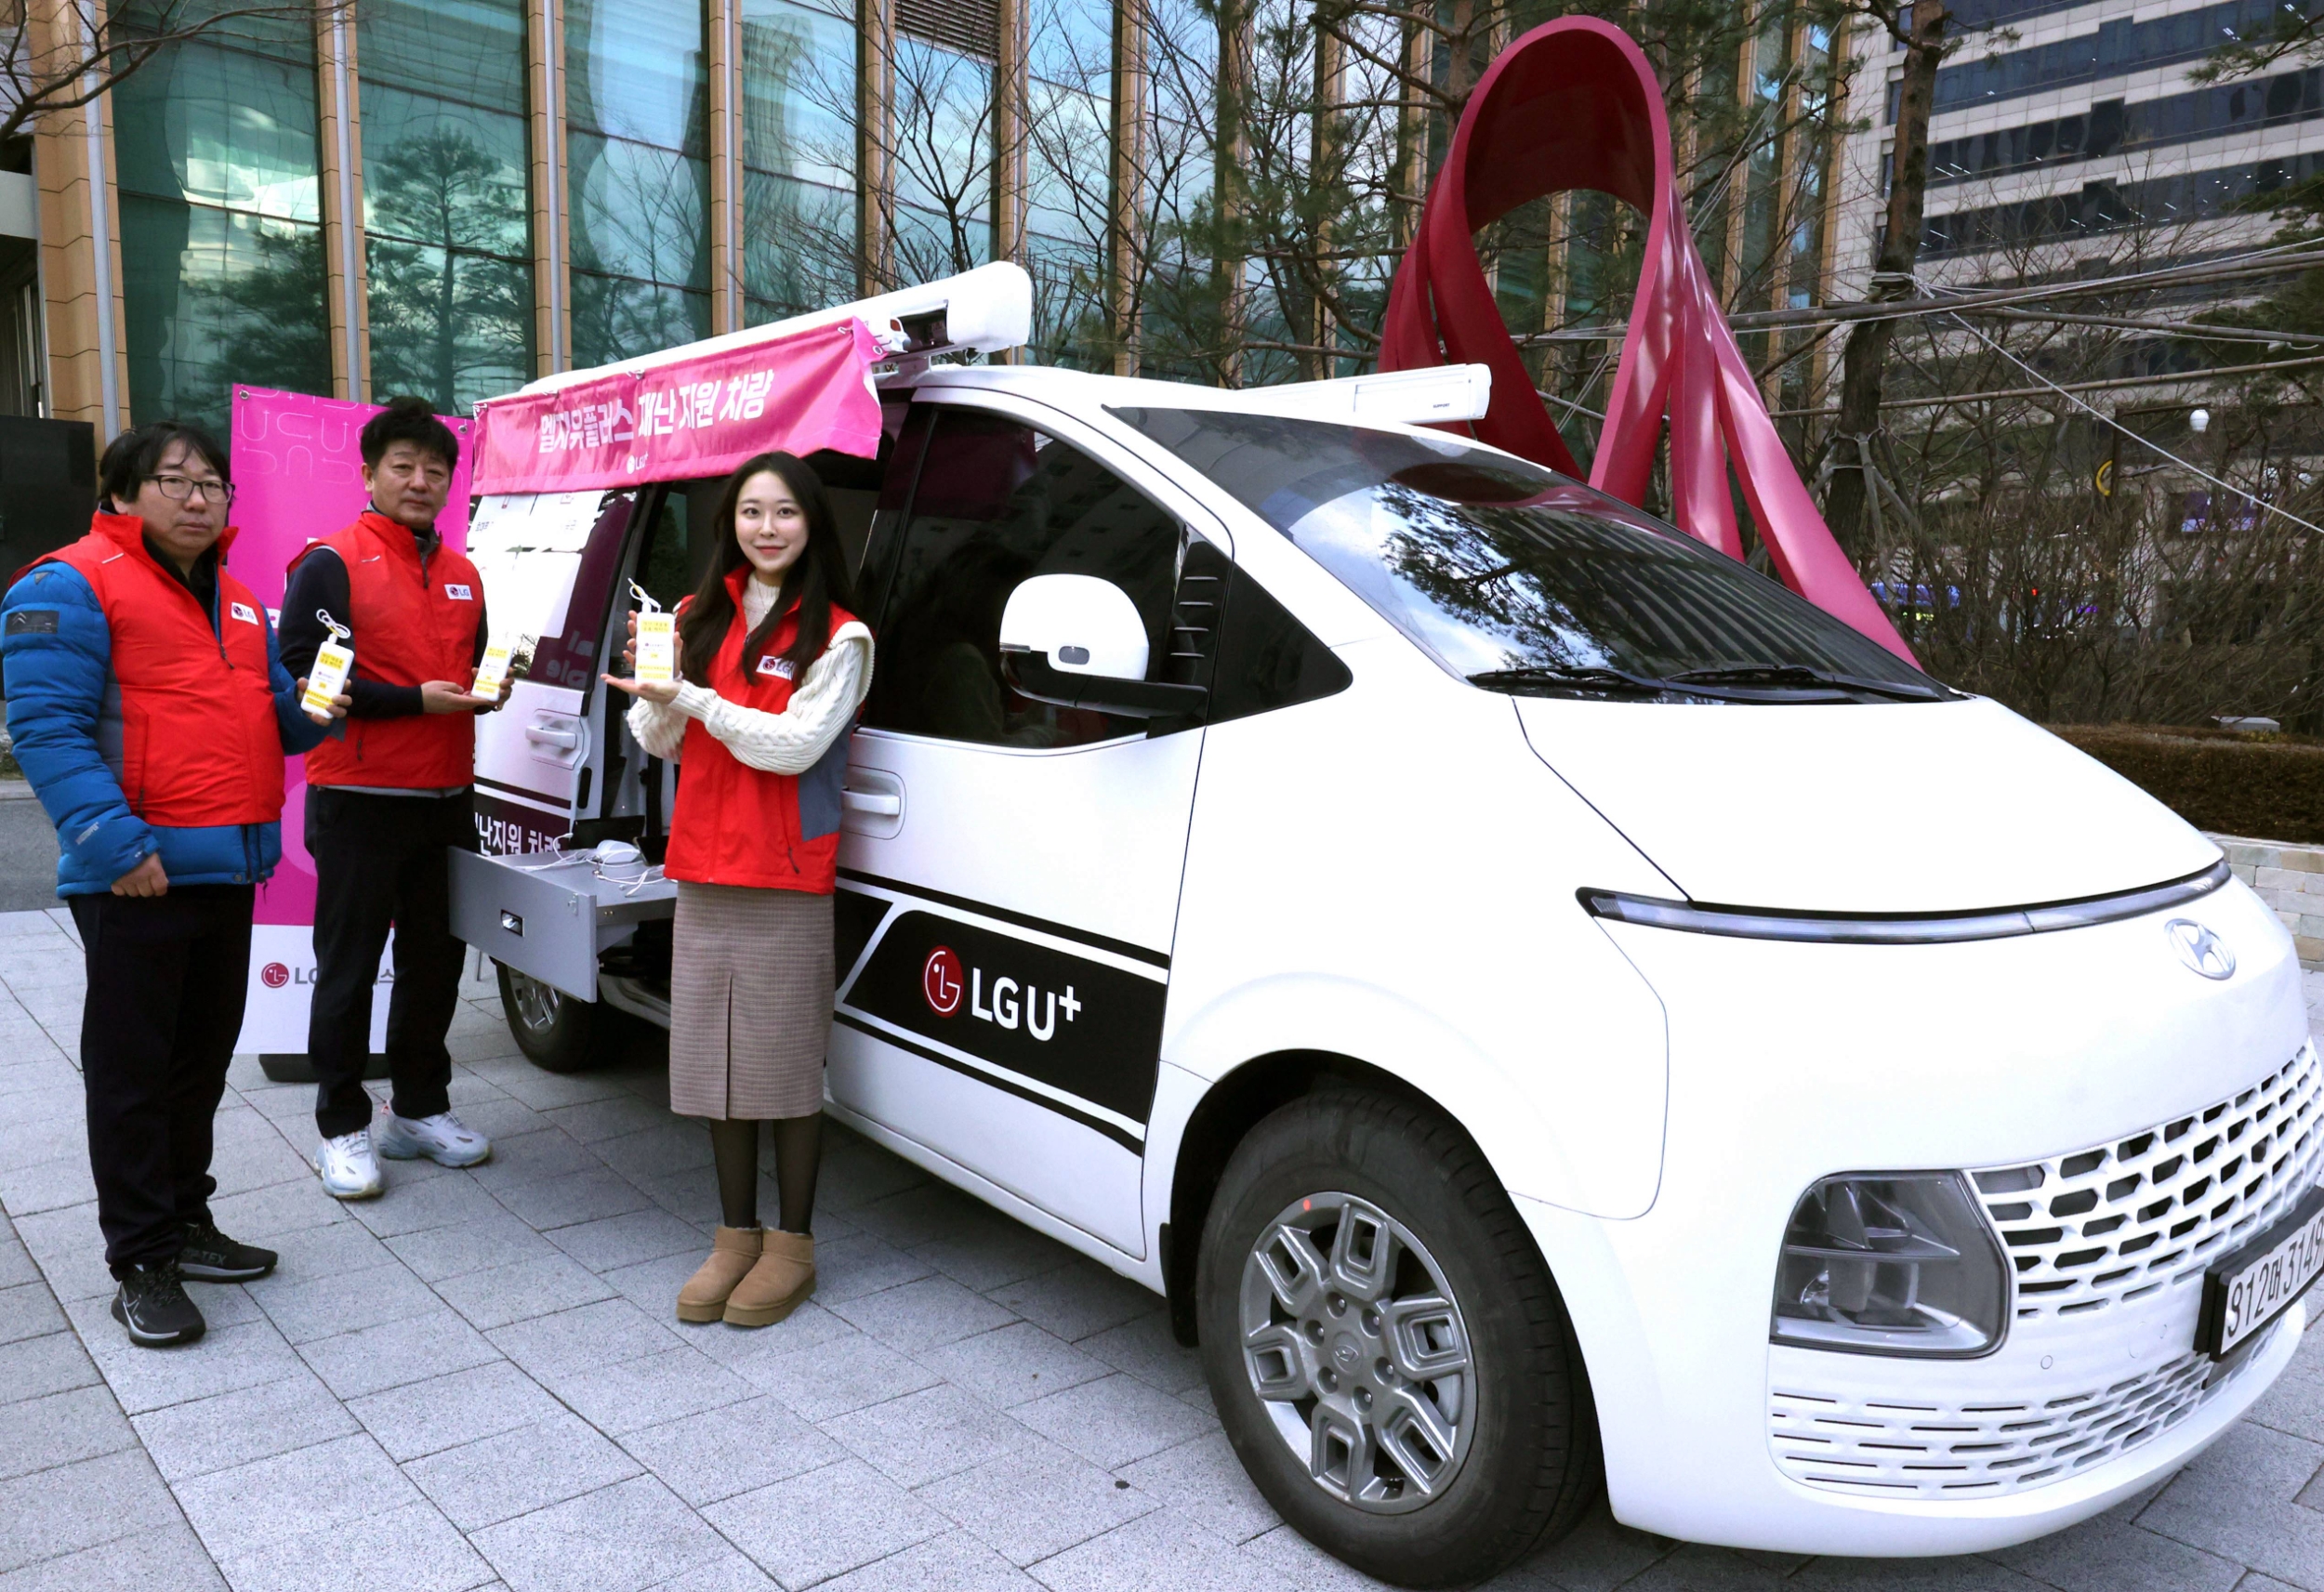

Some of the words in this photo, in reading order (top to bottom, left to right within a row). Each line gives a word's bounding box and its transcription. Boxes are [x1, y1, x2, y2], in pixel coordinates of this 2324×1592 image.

[538, 399, 634, 454] 엘지유플러스
[638, 388, 677, 437] 재난
[678, 379, 721, 429] 지원
[720, 369, 774, 421] 차량
[457, 588, 470, 597] LG
[243, 609, 255, 620] LG
[775, 660, 790, 674] LG
[475, 812, 522, 857] 난지원
[2283, 1216, 2324, 1295] 3149
